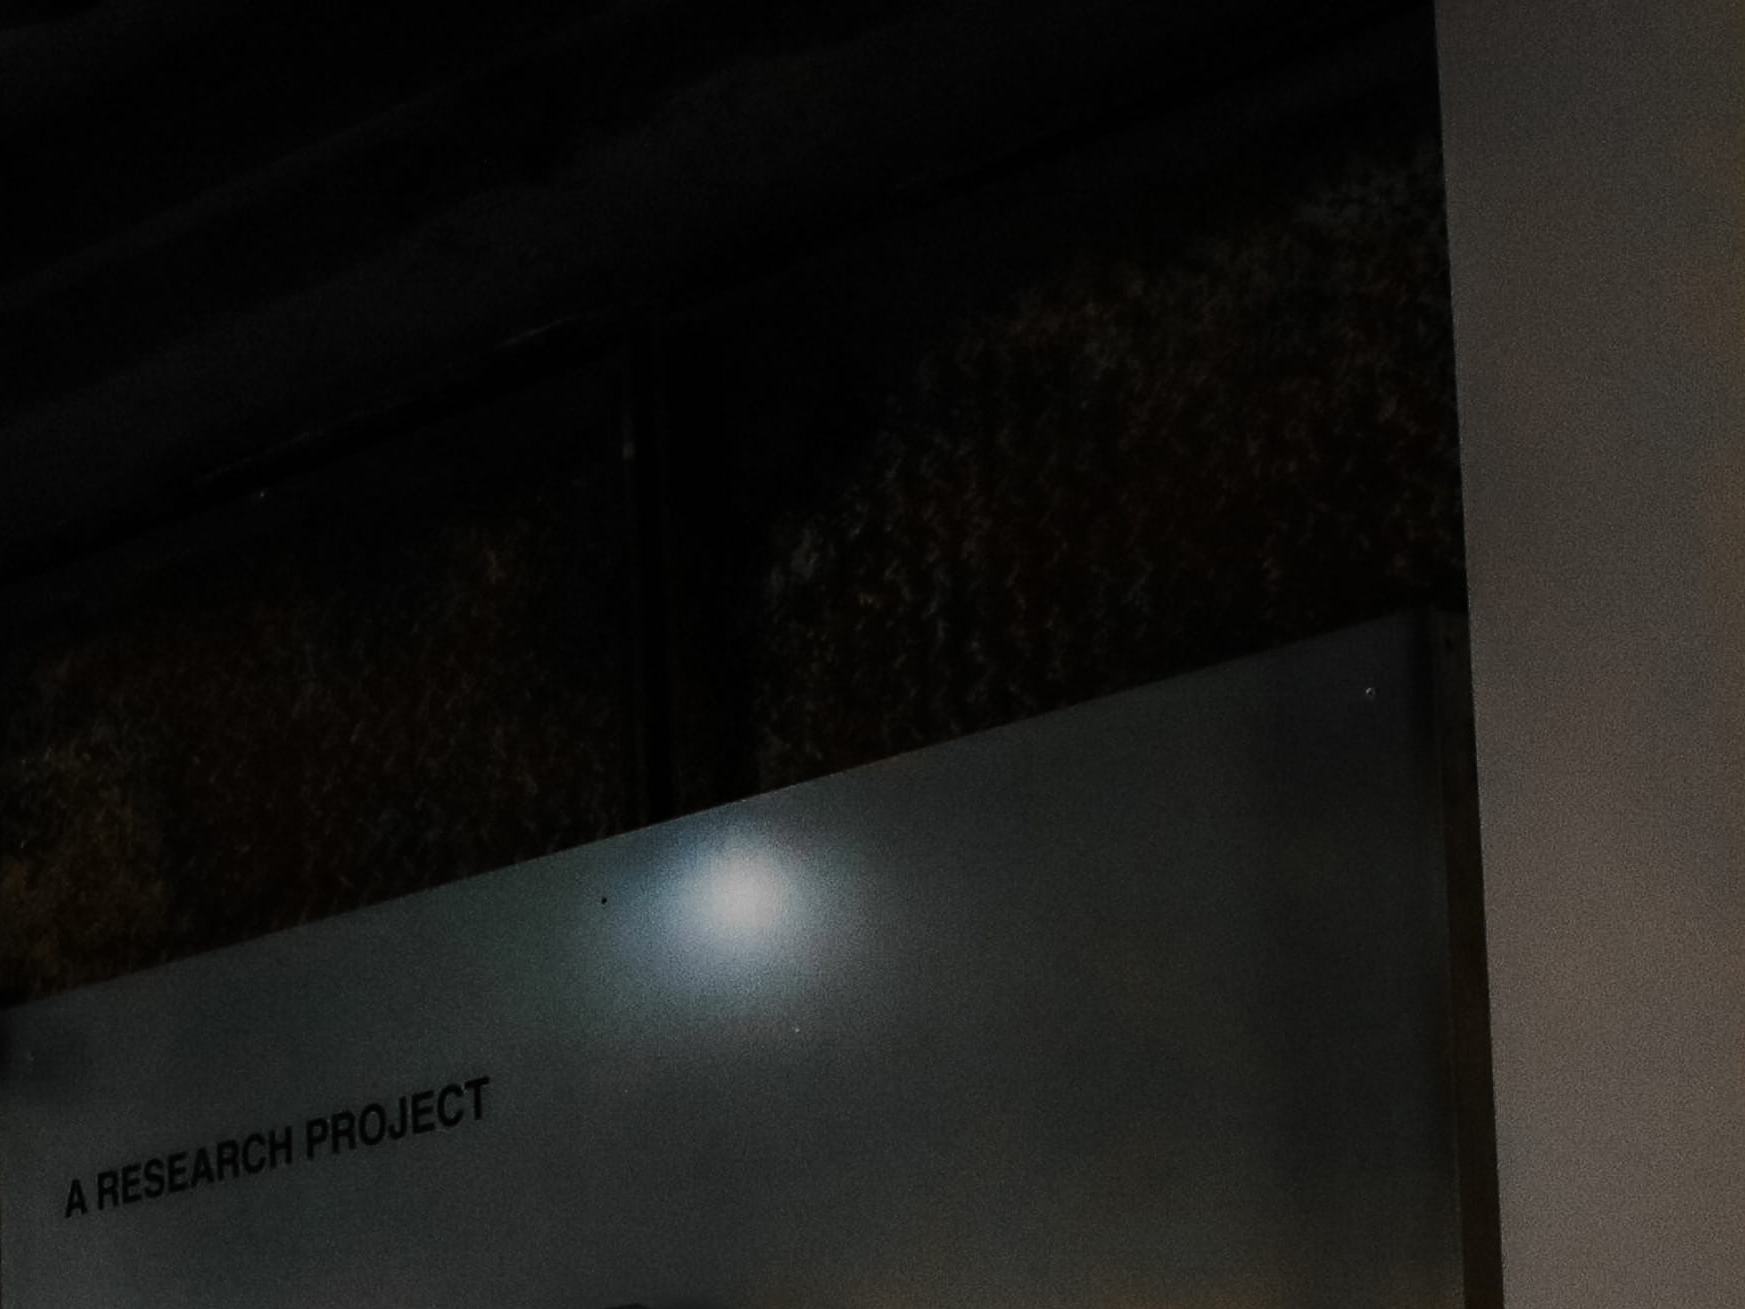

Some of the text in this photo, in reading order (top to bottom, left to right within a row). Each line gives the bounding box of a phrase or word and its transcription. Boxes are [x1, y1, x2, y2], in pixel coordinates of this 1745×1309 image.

[64, 1076, 489, 1218] A RESEARCH PROJECT
